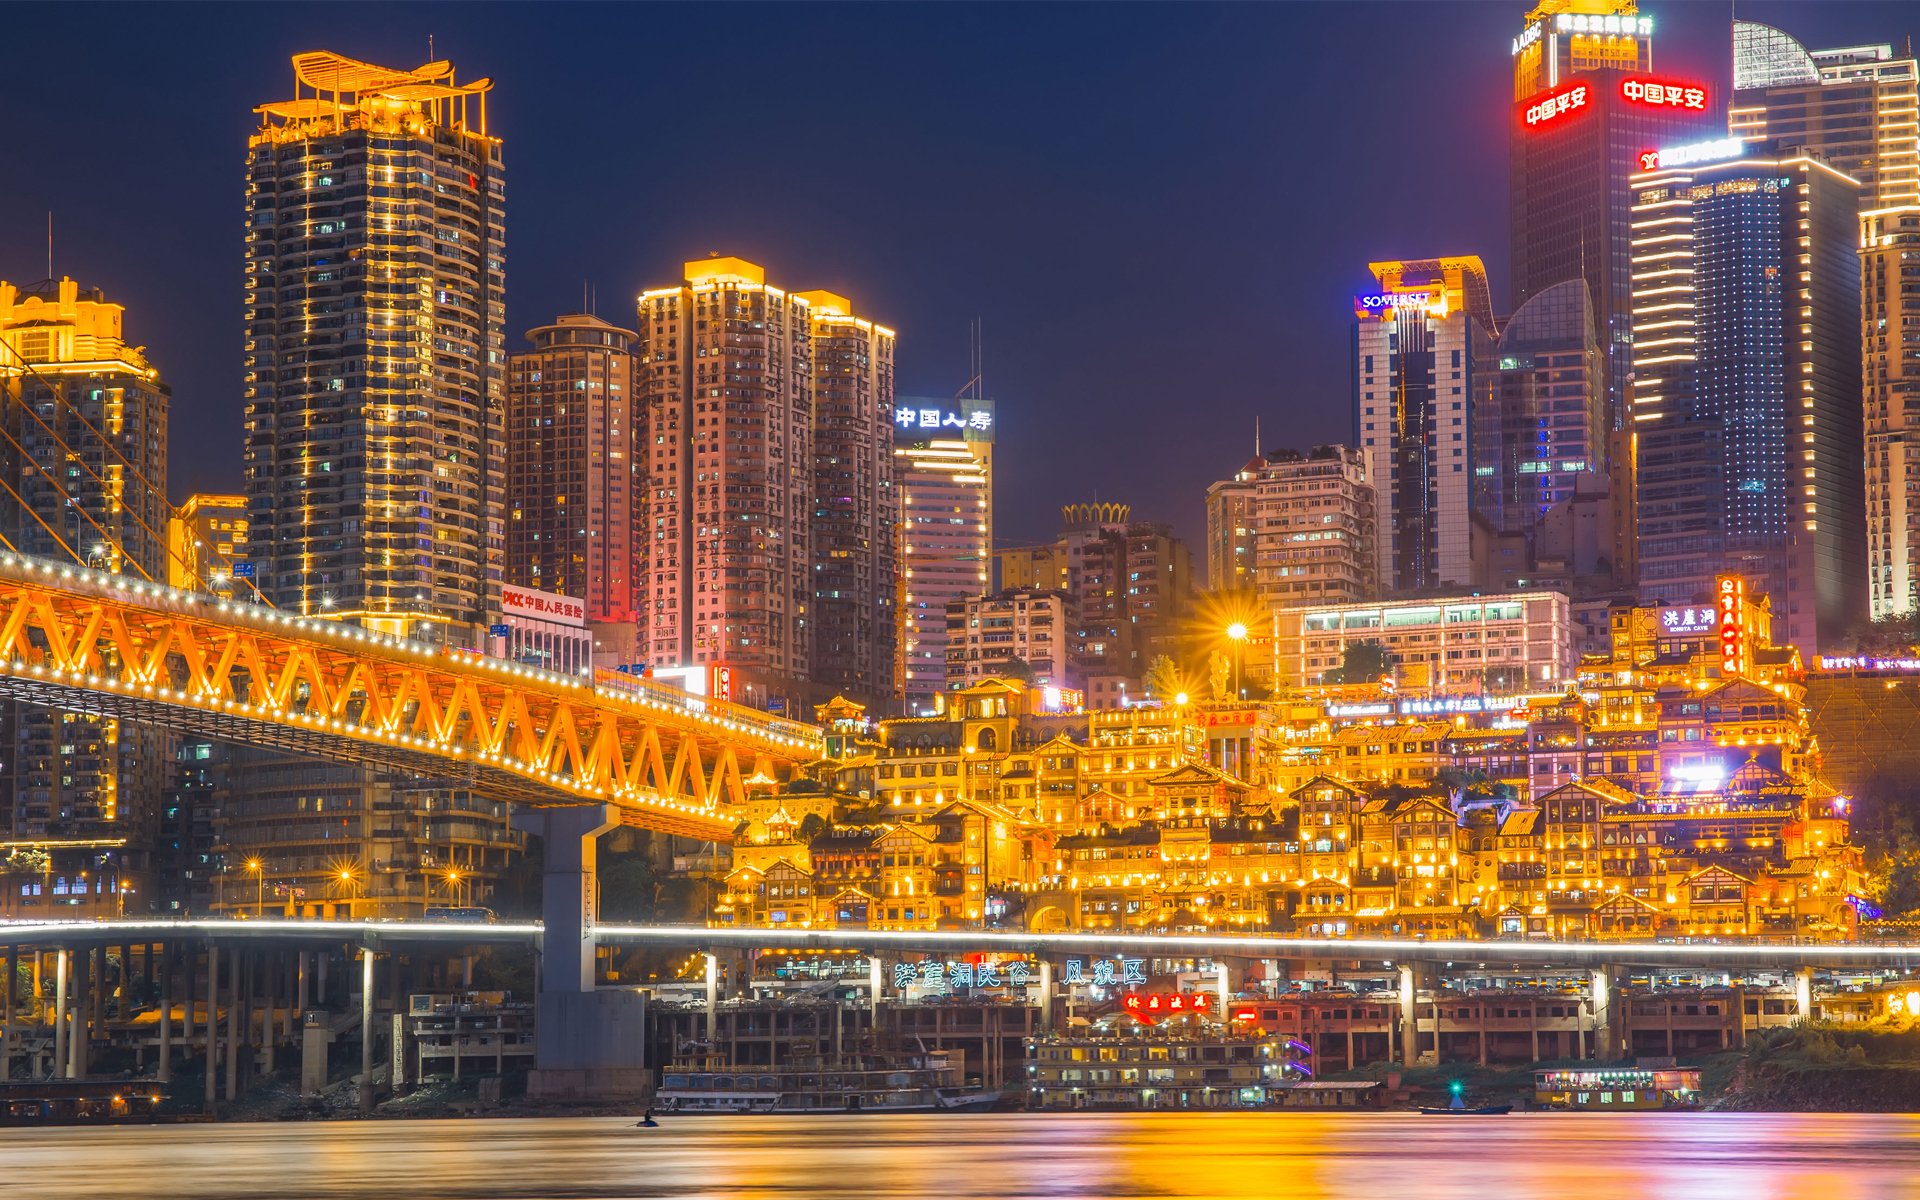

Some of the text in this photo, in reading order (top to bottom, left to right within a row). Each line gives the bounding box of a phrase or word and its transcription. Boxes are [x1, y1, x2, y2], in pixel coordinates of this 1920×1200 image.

[1526, 86, 1586, 125] 中国平安
[1623, 80, 1705, 109] 中国平安
[1362, 292, 1430, 308] SOMERSET
[895, 407, 992, 431] 中国人寿
[502, 590, 583, 619] PICC 中国人民保险
[1662, 608, 1715, 627] 洪崖洞
[894, 959, 1147, 988] 洪崖洞民俗 风貌区
